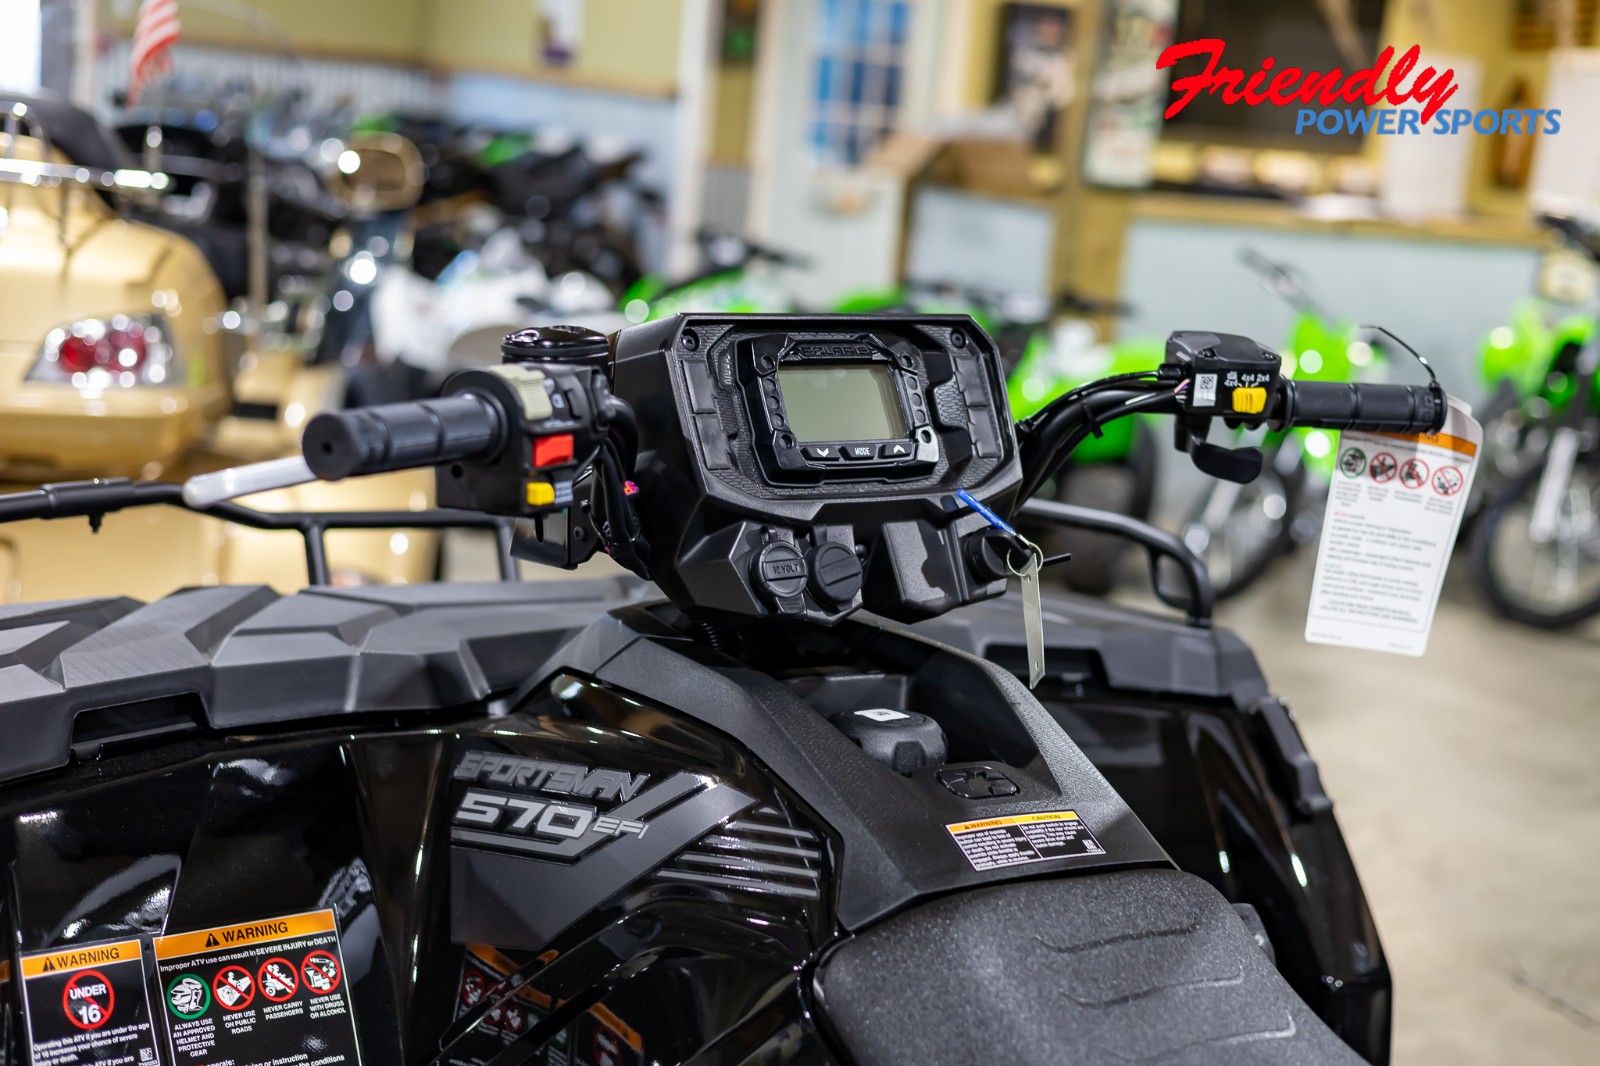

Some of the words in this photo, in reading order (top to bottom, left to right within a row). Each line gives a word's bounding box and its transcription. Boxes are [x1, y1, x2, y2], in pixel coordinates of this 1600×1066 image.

[854, 445, 871, 457] MODE
[772, 565, 781, 574] 12
[781, 564, 799, 574] VOLT
[453, 751, 651, 803] SPORTSMAN
[454, 789, 597, 839] 570
[592, 816, 651, 840] EFI
[222, 922, 289, 943] WARNING
[56, 947, 120, 968] WARNING
[160, 960, 191, 974] Improper
[191, 957, 206, 967] ATV
[206, 956, 218, 965] use
[218, 954, 231, 963] can
[230, 951, 249, 961] result
[249, 949, 256, 958] in
[255, 944, 283, 956] SEVERE
[282, 940, 307, 953] INJURY
[306, 939, 314, 947] or
[313, 935, 337, 946] DEATH
[69, 983, 107, 1000] UNDER
[309, 995, 330, 1006] NEVER
[329, 993, 342, 1001] USE
[309, 1003, 326, 1012] WITH
[325, 1000, 345, 1010] DRUGS
[262, 1004, 283, 1014] NEVER
[283, 1001, 304, 1010] CARRY
[310, 1012, 320, 1020] OR
[319, 1008, 347, 1018] ALCOHOL
[78, 1004, 102, 1025] 16
[222, 1012, 243, 1022] NEVER
[243, 1010, 256, 1018] USE
[265, 1008, 304, 1021] PASSENGERS
[174, 1020, 201, 1032] ALWAYS
[200, 1017, 213, 1026] USE
[225, 1021, 235, 1029] ON
[235, 1017, 256, 1027] PUBLIC
[73, 1035, 86, 1044] ATV
[111, 1027, 127, 1036] under
[127, 1024, 138, 1033] the
[138, 1022, 150, 1032] age
[173, 1031, 183, 1039] AN
[182, 1025, 216, 1037] APPROVED
[231, 1025, 253, 1035] ROADS
[77, 1042, 91, 1052] your
[91, 1039, 112, 1048] chance
[119, 1033, 138, 1043] severe
[175, 1035, 202, 1046] HELMET
[201, 1033, 215, 1042] AND
[177, 1040, 216, 1053] PROTECTIVE
[190, 1048, 208, 1058] GEAR
[272, 1052, 309, 1066] instruction
[310, 1053, 346, 1066] conditions
